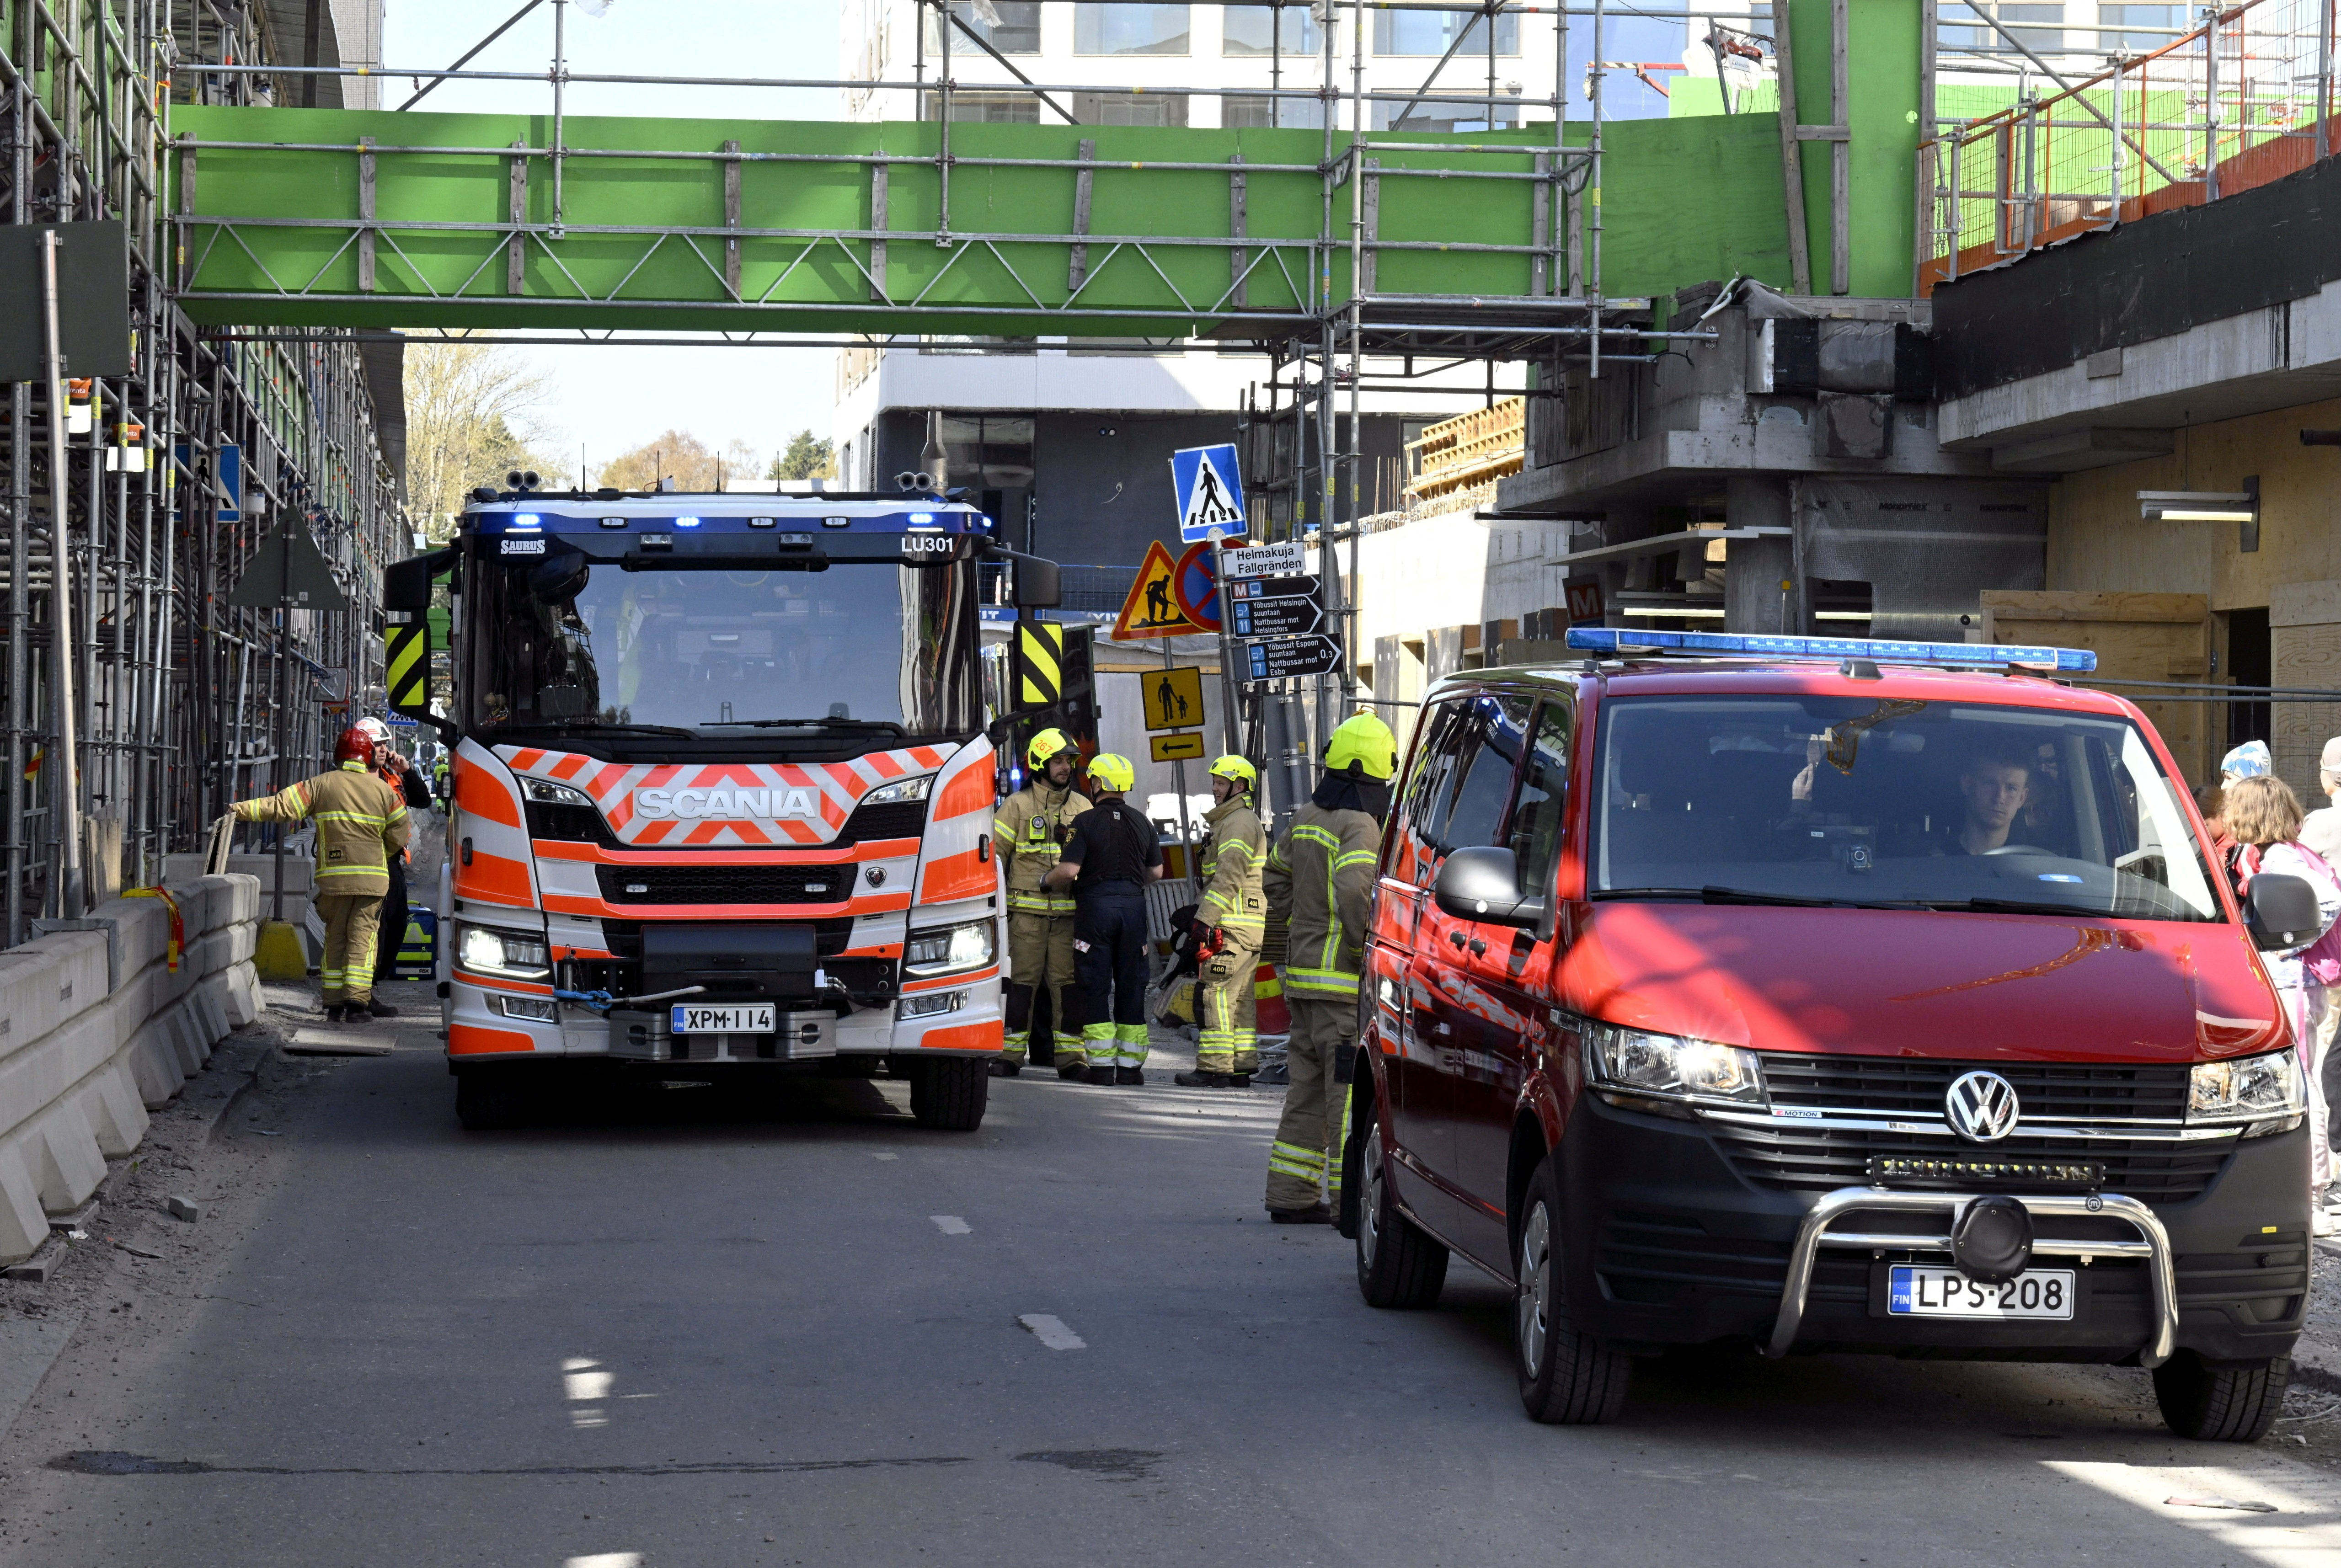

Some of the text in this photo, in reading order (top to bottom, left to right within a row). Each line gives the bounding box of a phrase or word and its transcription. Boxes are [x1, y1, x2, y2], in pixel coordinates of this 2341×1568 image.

[902, 537, 953, 552] LU301
[1236, 547, 1294, 560] Helmakuja
[1238, 560, 1302, 574] Fållgränden
[1235, 584, 1246, 597] M
[1253, 599, 1306, 609] Yöbussit Helsingin
[1571, 587, 1599, 616] M
[979, 611, 999, 619] IT
[1240, 620, 1248, 632] 11
[1254, 618, 1286, 626] Nattbussar
[1267, 640, 1319, 651] Yöbussit Espoon
[1268, 650, 1296, 658] suuntaan
[1320, 649, 1333, 659] 0,3
[1256, 663, 1261, 675] 7
[1269, 659, 1303, 668] Nattbussar
[1035, 740, 1053, 754] 267
[637, 790, 816, 818] SCANIA
[688, 1010, 770, 1028] XPM-114
[1919, 1275, 2063, 1310] LPS-208
[1893, 1295, 1910, 1305] FIN
